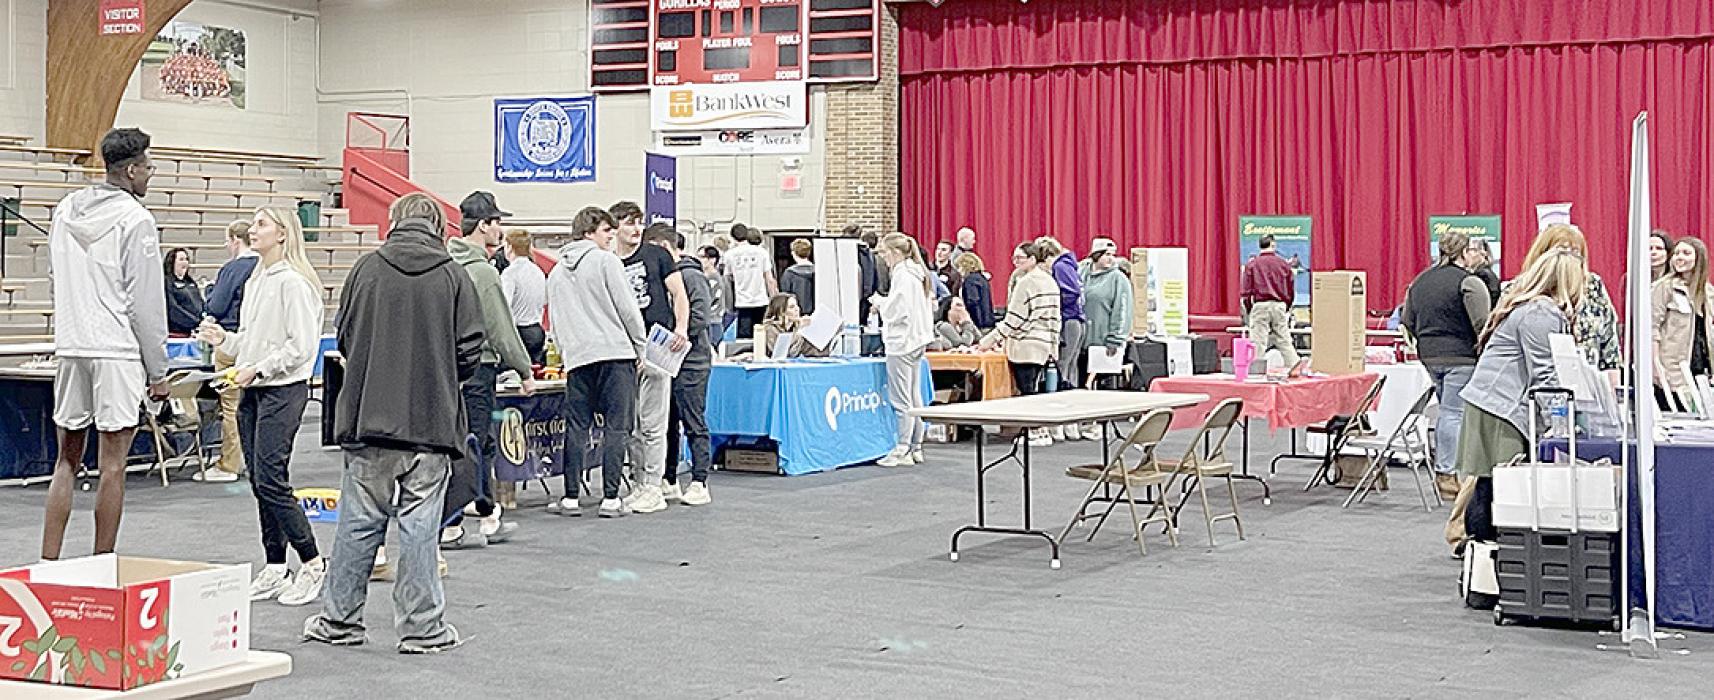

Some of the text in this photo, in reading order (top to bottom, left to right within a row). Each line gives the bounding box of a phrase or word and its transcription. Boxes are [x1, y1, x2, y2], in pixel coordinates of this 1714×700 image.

[104, 7, 140, 20] VISITOR
[103, 23, 142, 34] SECTION
[696, 93, 791, 111] BankWest
[718, 131, 754, 143] CORE
[140, 587, 159, 630] 2
